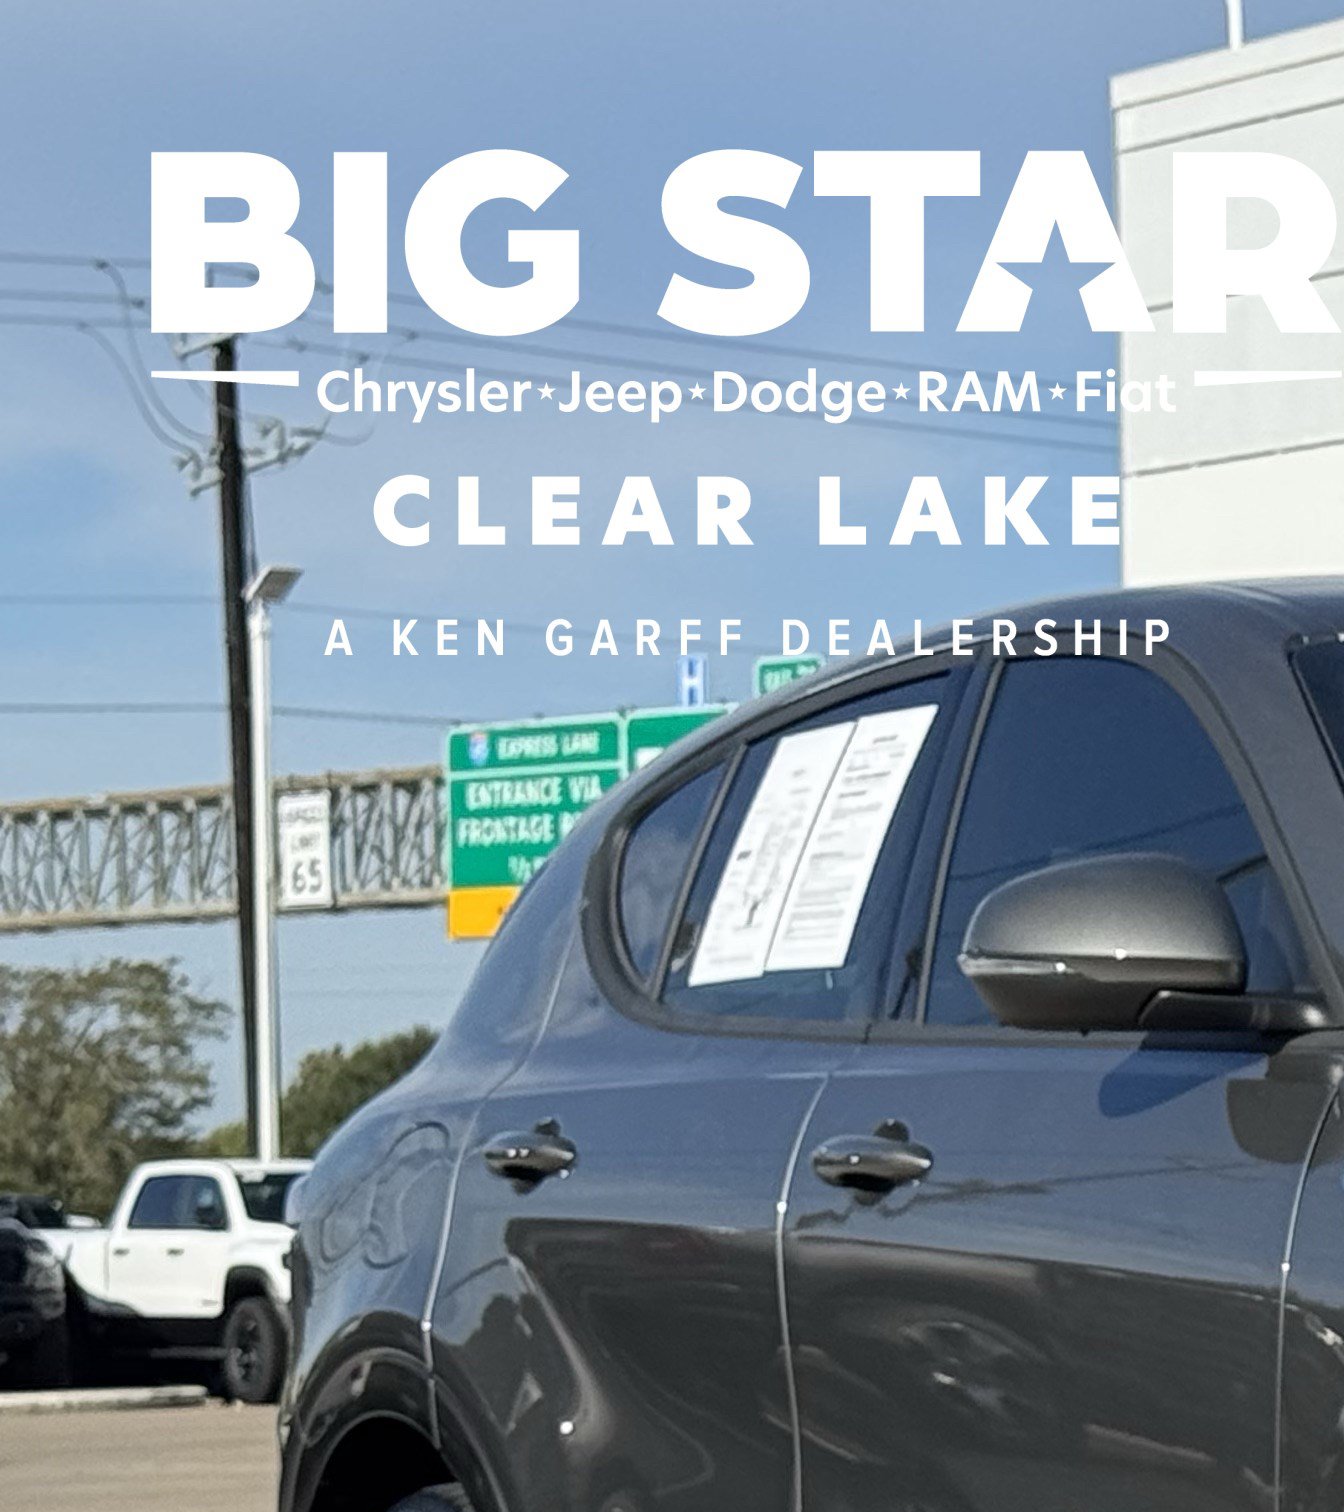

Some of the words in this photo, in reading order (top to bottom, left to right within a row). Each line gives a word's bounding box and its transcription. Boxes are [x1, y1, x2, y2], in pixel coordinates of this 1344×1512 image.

[560, 730, 600, 756] LANE
[465, 777, 562, 811] ENTRANCE
[567, 775, 604, 804] VIA
[456, 813, 555, 848] FRONTAGE
[292, 857, 323, 895] 65
